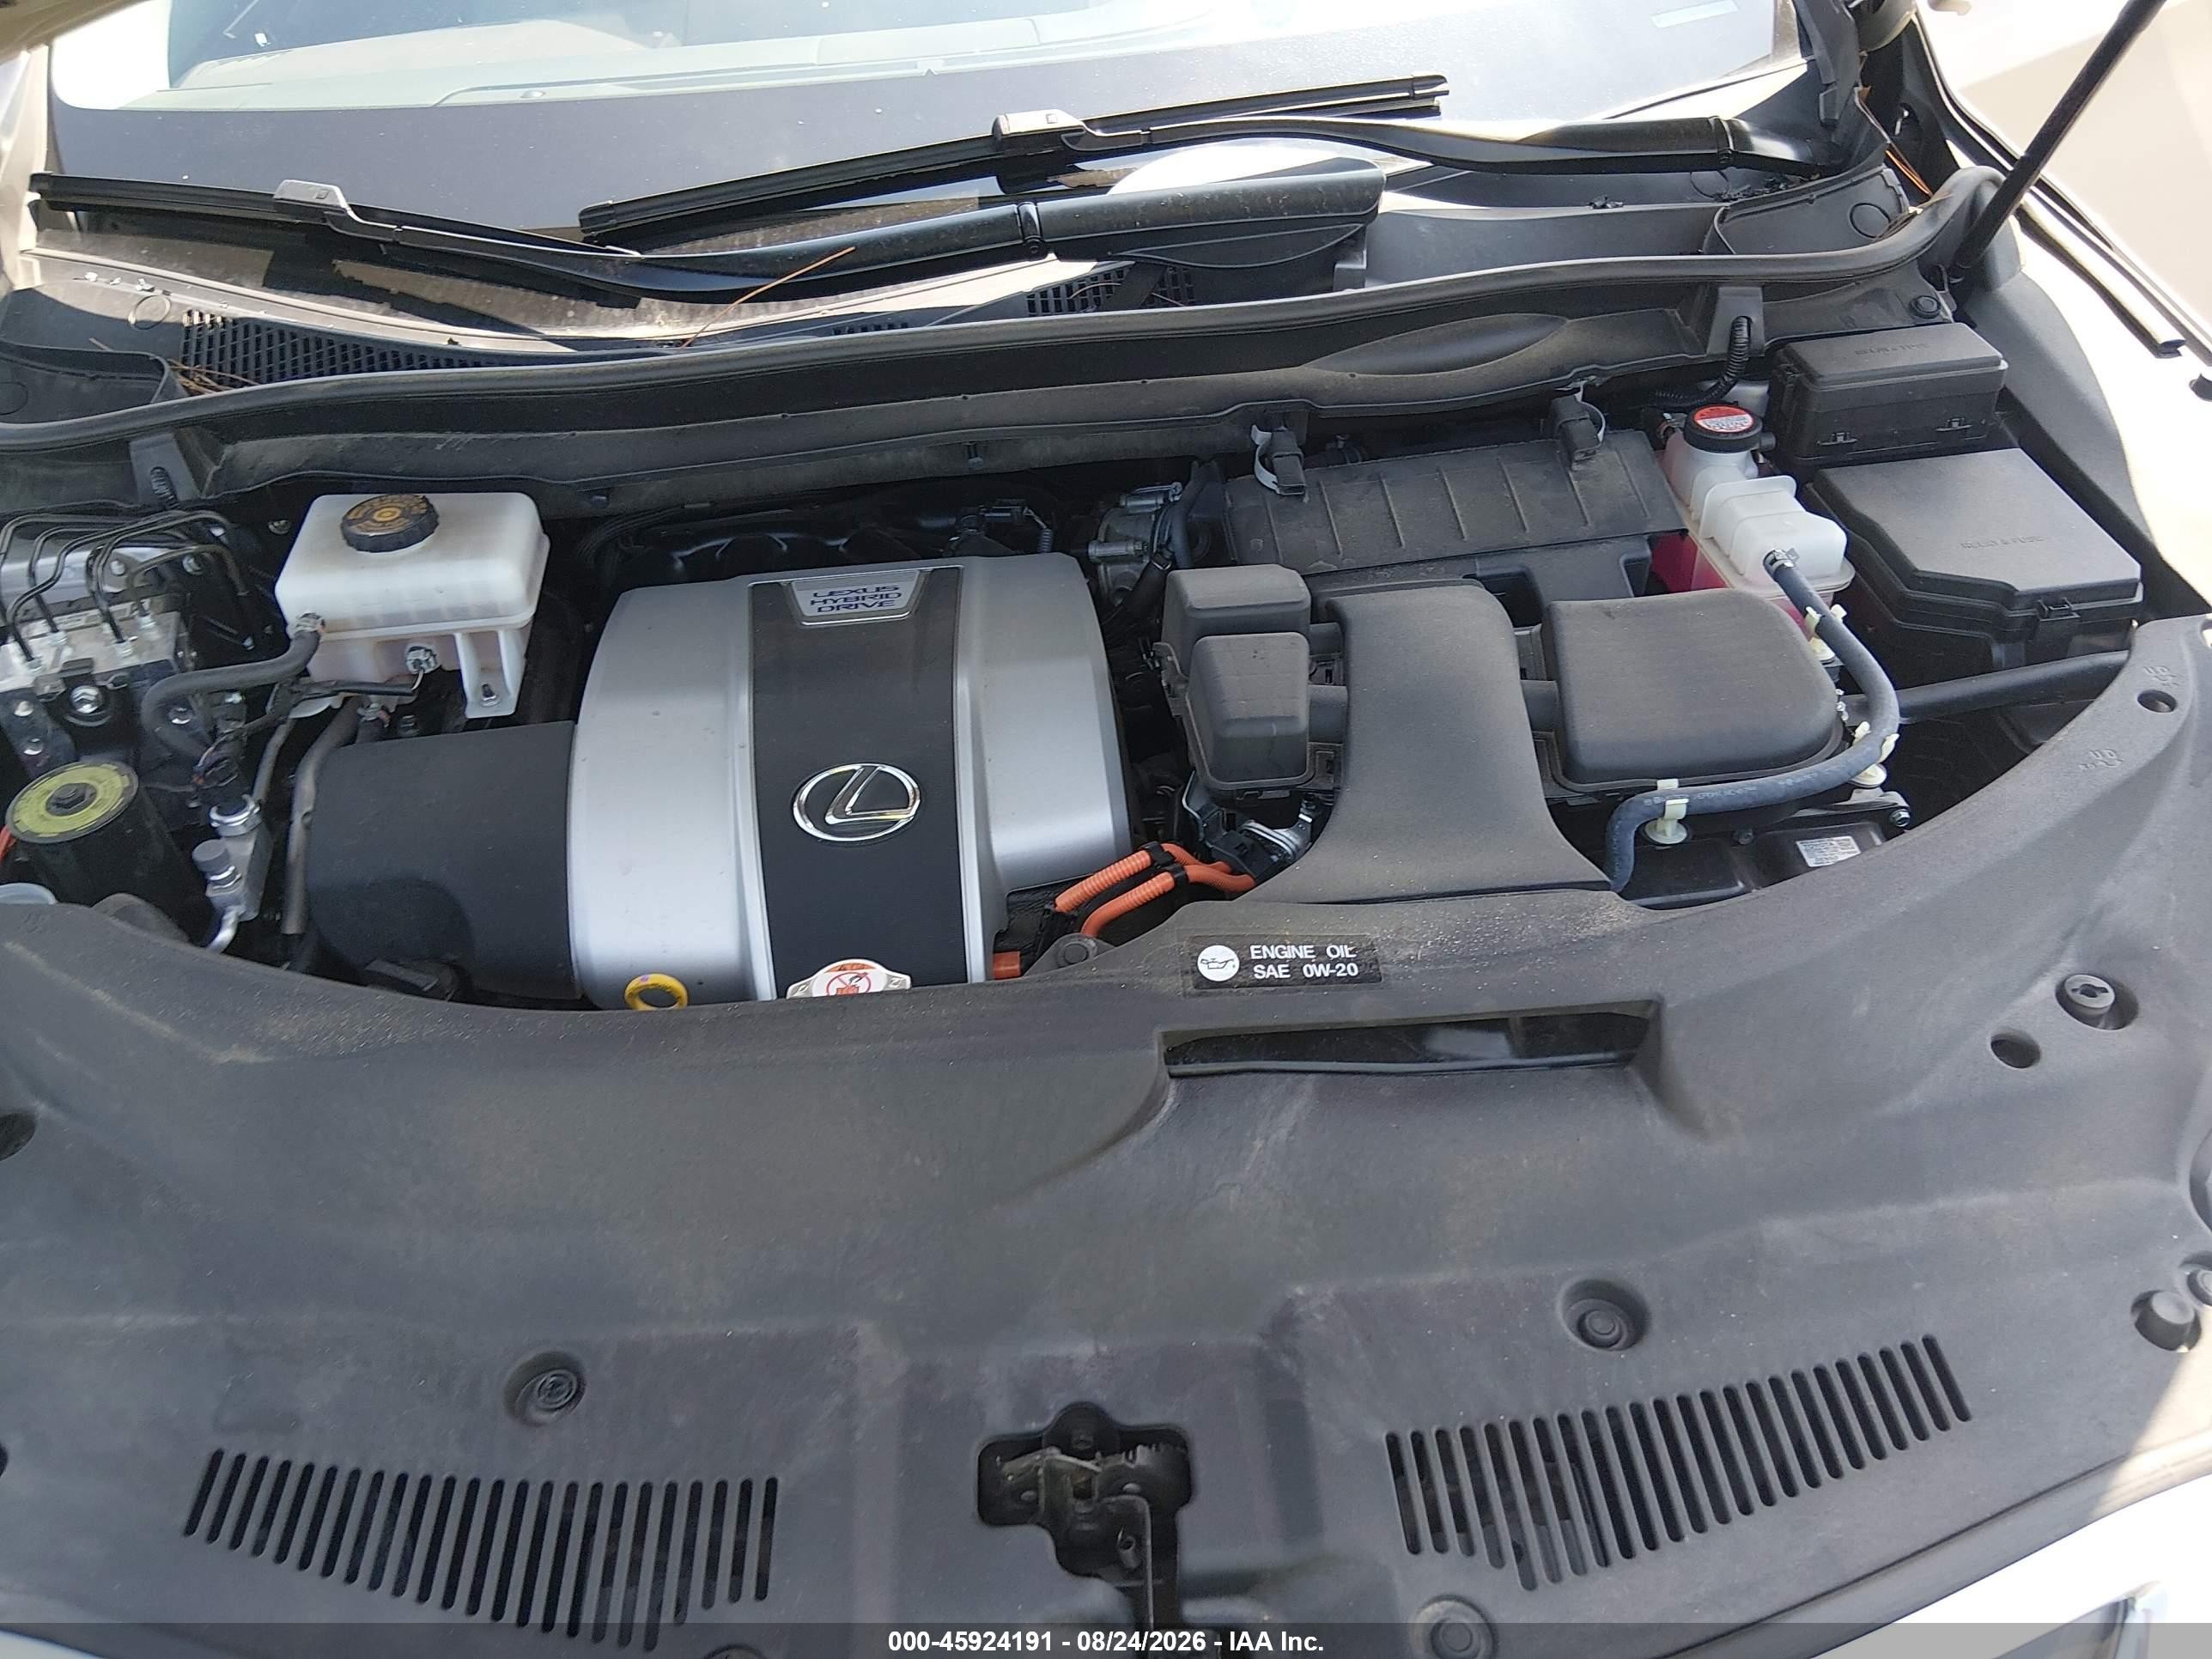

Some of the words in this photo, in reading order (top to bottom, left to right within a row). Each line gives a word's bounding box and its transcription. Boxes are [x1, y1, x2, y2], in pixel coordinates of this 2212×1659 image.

[813, 585, 900, 598] LEXUS
[810, 592, 902, 606] HYBRID
[817, 599, 896, 613] DRIVE
[1249, 945, 1316, 960] ENGINE
[1326, 945, 1357, 958] OIL
[1253, 963, 1291, 979] SAE
[1302, 962, 1359, 979] 0W-20
